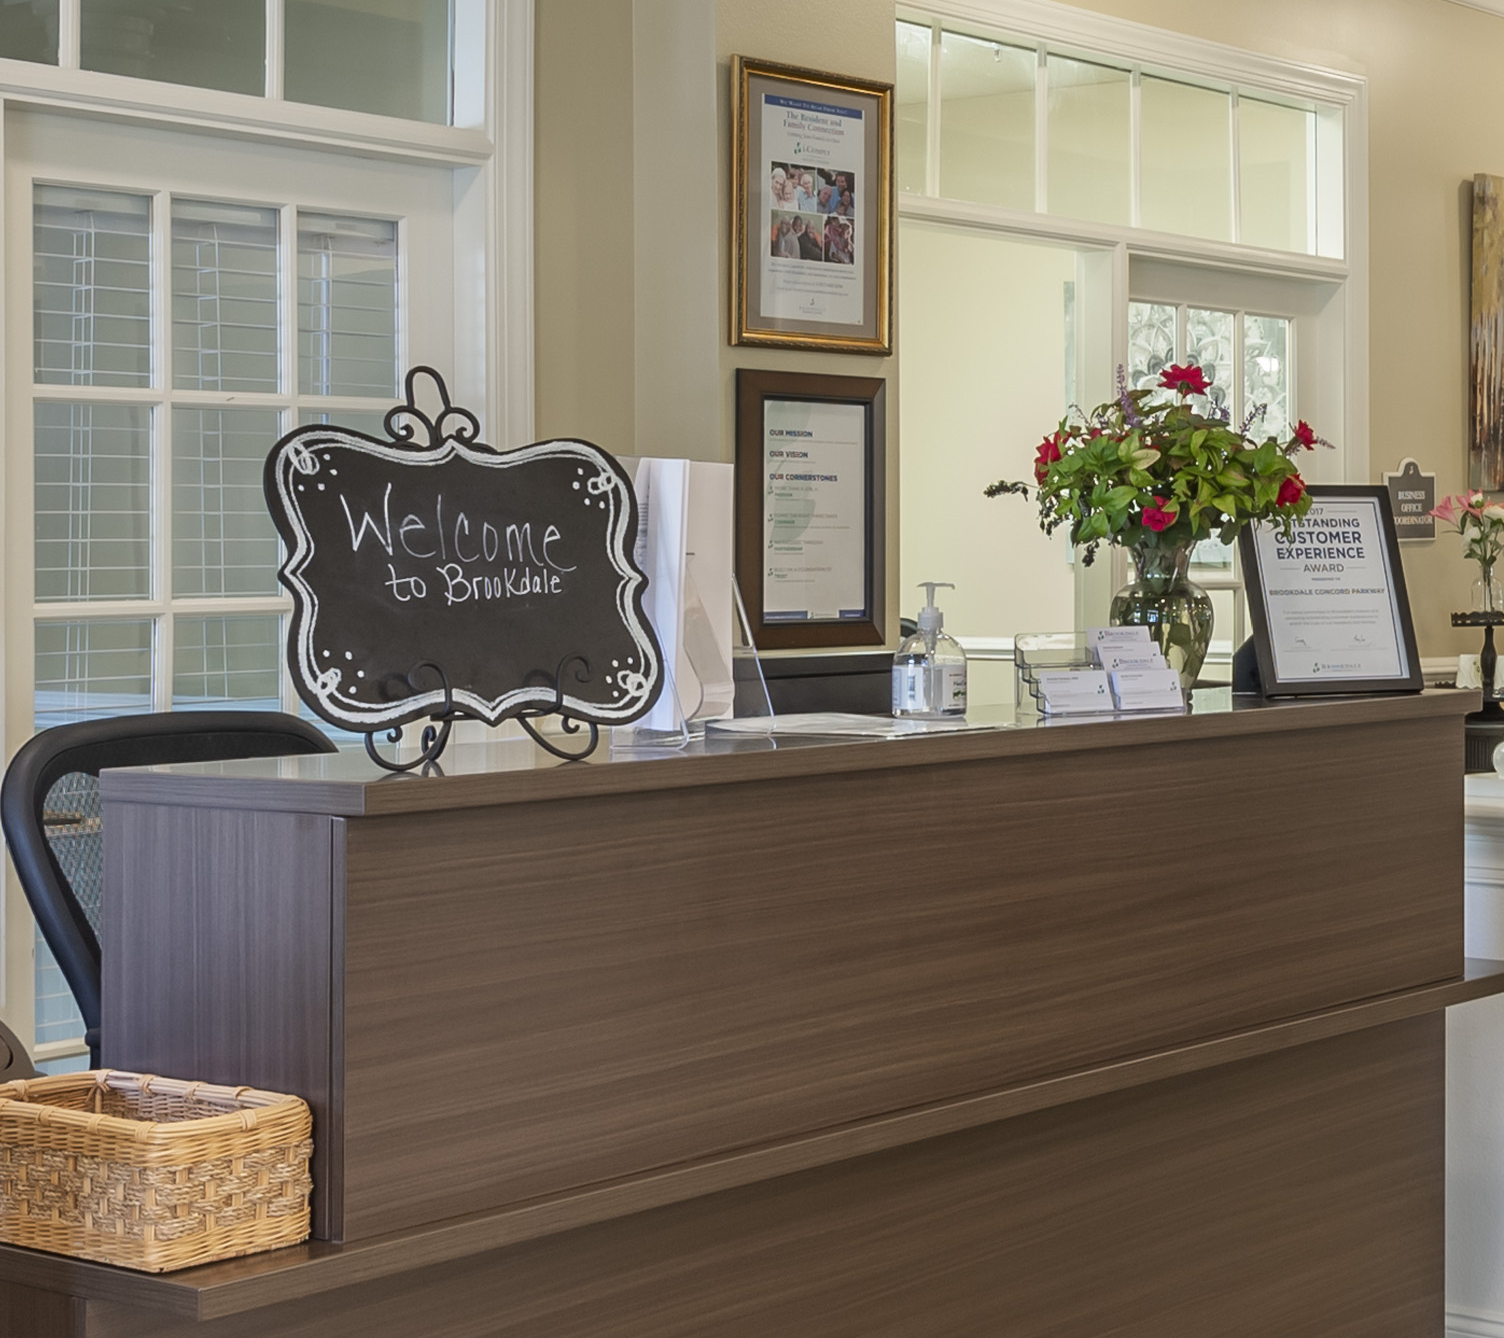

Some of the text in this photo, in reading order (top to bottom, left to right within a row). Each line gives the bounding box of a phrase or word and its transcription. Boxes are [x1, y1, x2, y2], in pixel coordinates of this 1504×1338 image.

[785, 429, 813, 437] MISSION
[769, 473, 838, 482] OUR CORNERSTONES
[1398, 491, 1426, 500] BUSINESS
[1401, 503, 1423, 513] OFFICE
[339, 481, 577, 572] Welcome
[1274, 531, 1362, 545] CUSTOMER
[1276, 547, 1365, 560] EXPERIENCE
[1303, 563, 1344, 573] AWARD
[384, 563, 427, 602] to
